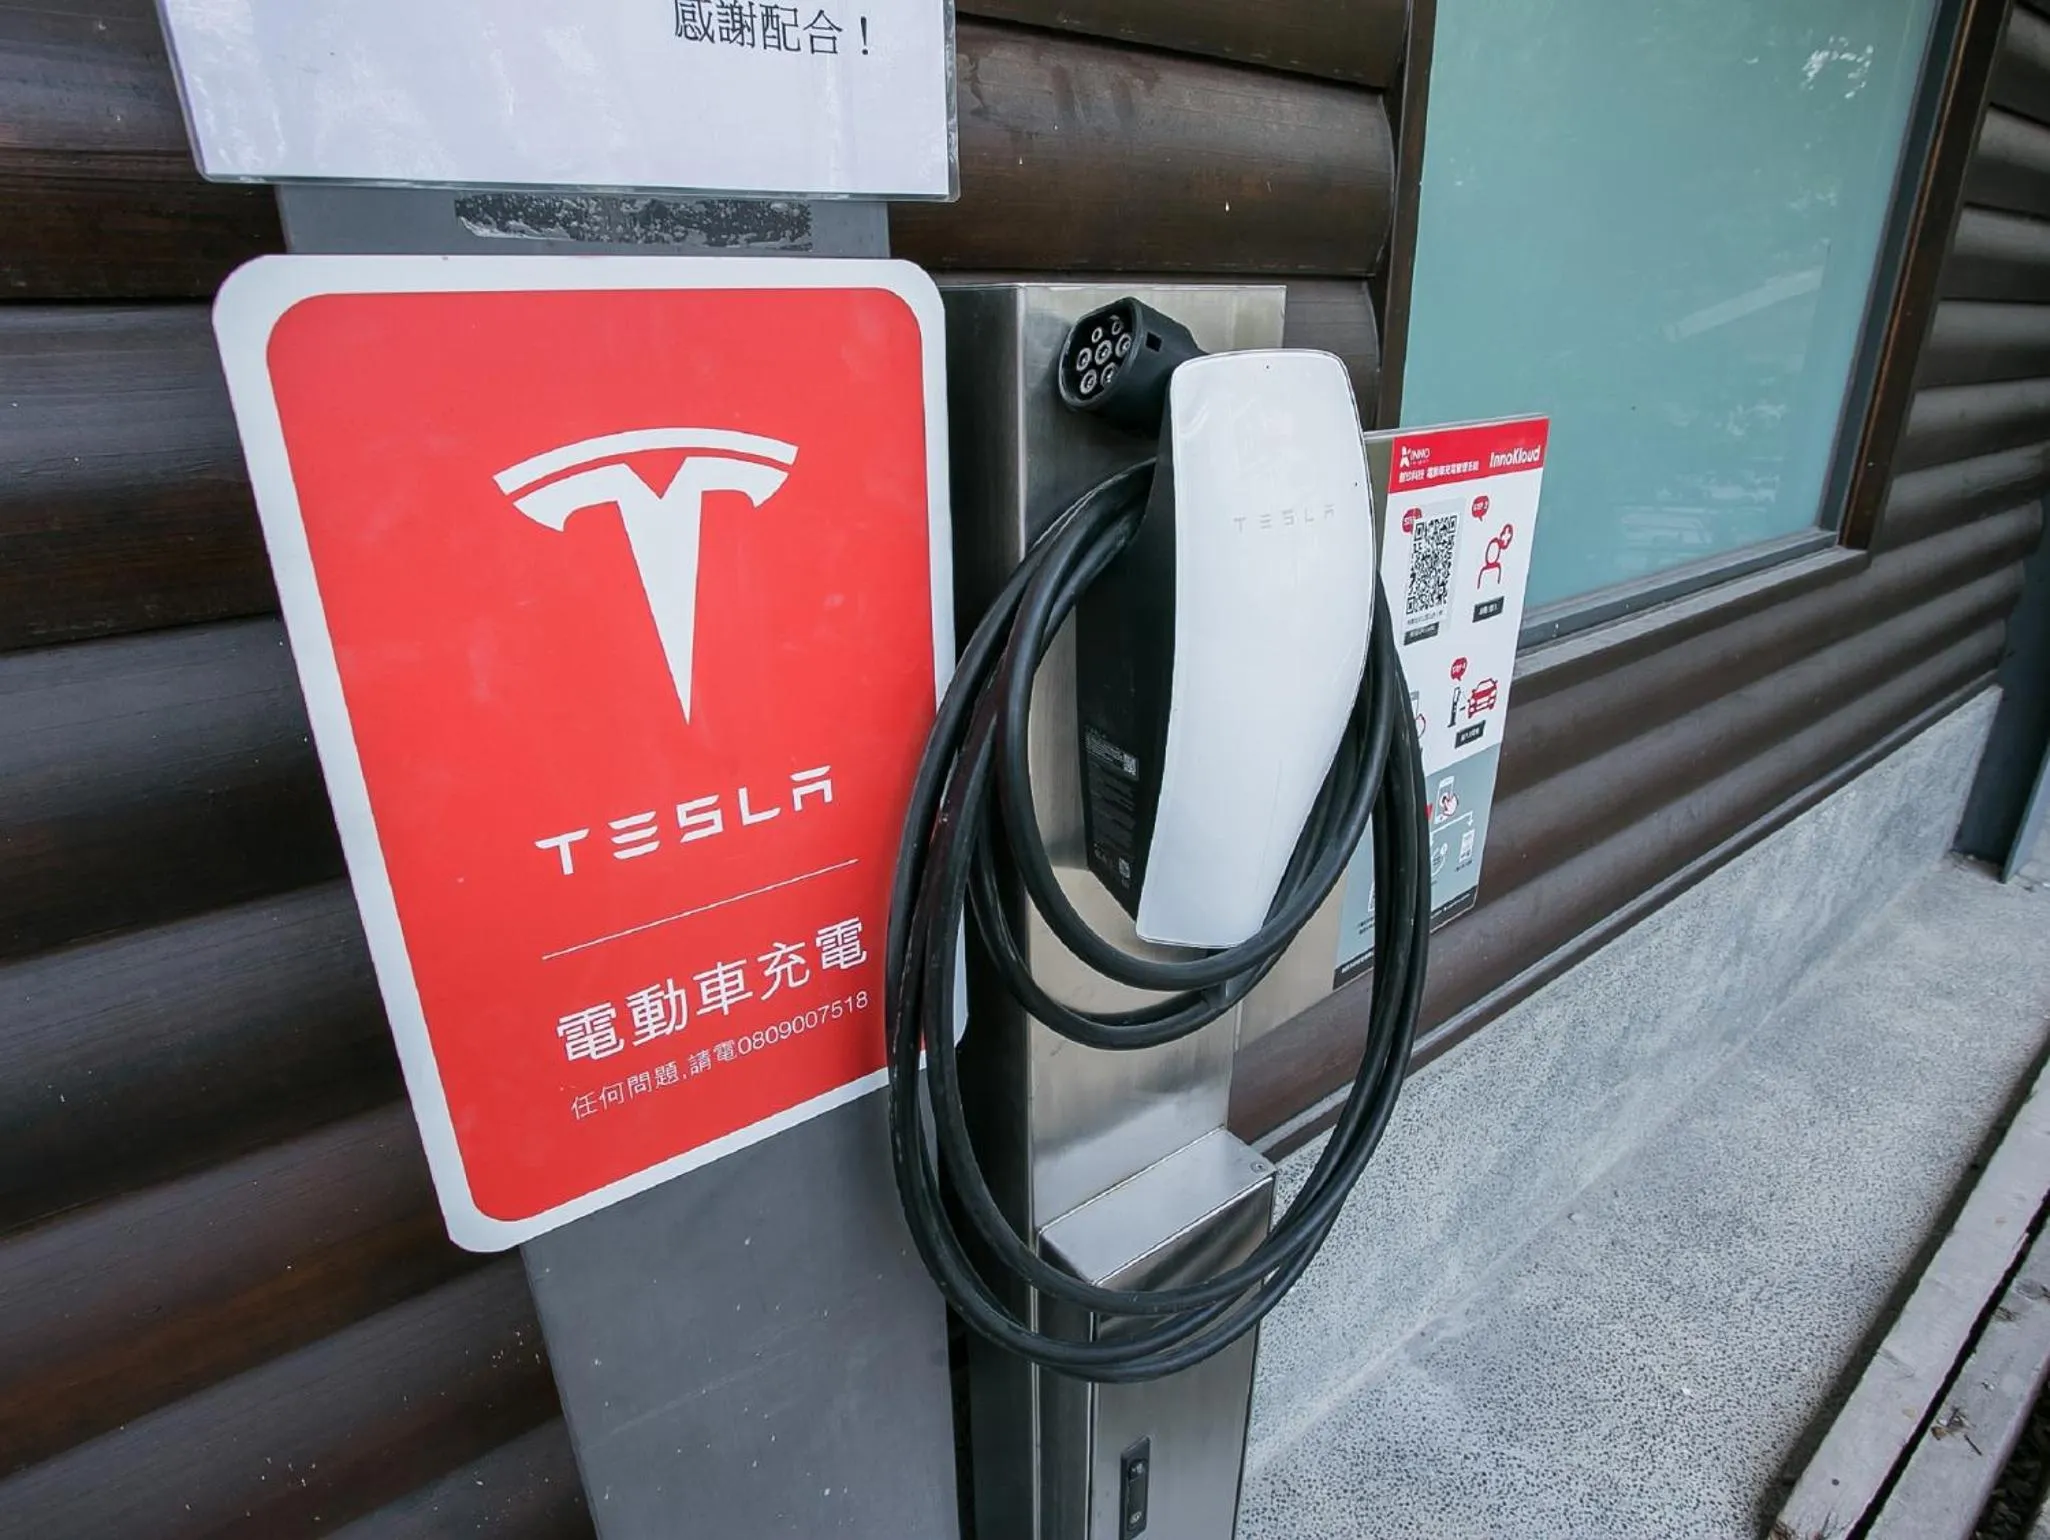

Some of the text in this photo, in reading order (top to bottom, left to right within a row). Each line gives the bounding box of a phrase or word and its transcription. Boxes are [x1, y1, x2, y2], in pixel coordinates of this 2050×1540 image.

[1489, 445, 1541, 468] InnoKloud
[1233, 503, 1335, 533] TESLA
[535, 765, 833, 876] TESLA
[556, 916, 867, 1061] 電動車充電
